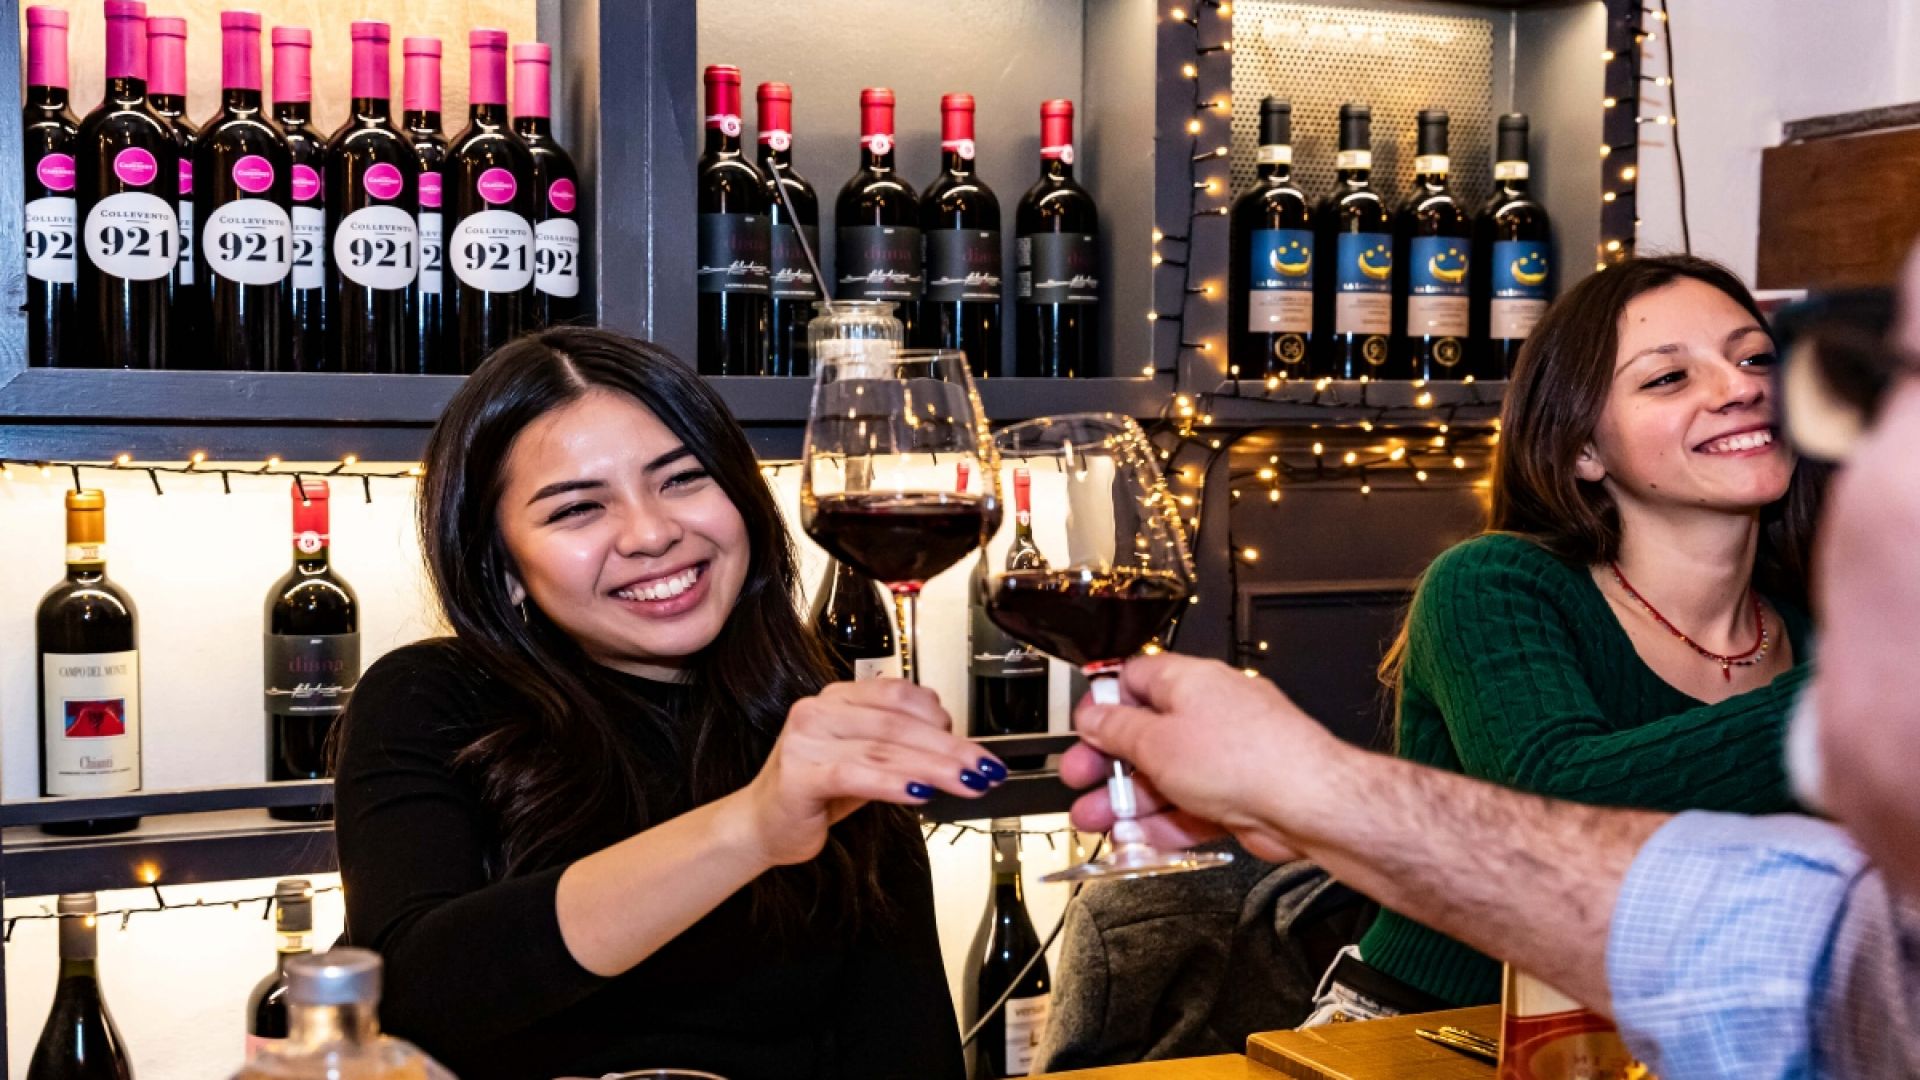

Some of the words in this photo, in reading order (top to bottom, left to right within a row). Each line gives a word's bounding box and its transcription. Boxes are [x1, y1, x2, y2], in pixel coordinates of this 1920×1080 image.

[100, 226, 170, 258] 921
[218, 232, 286, 263] 921
[349, 238, 413, 269] 921
[464, 242, 527, 271] 921
[535, 248, 578, 275] 92
